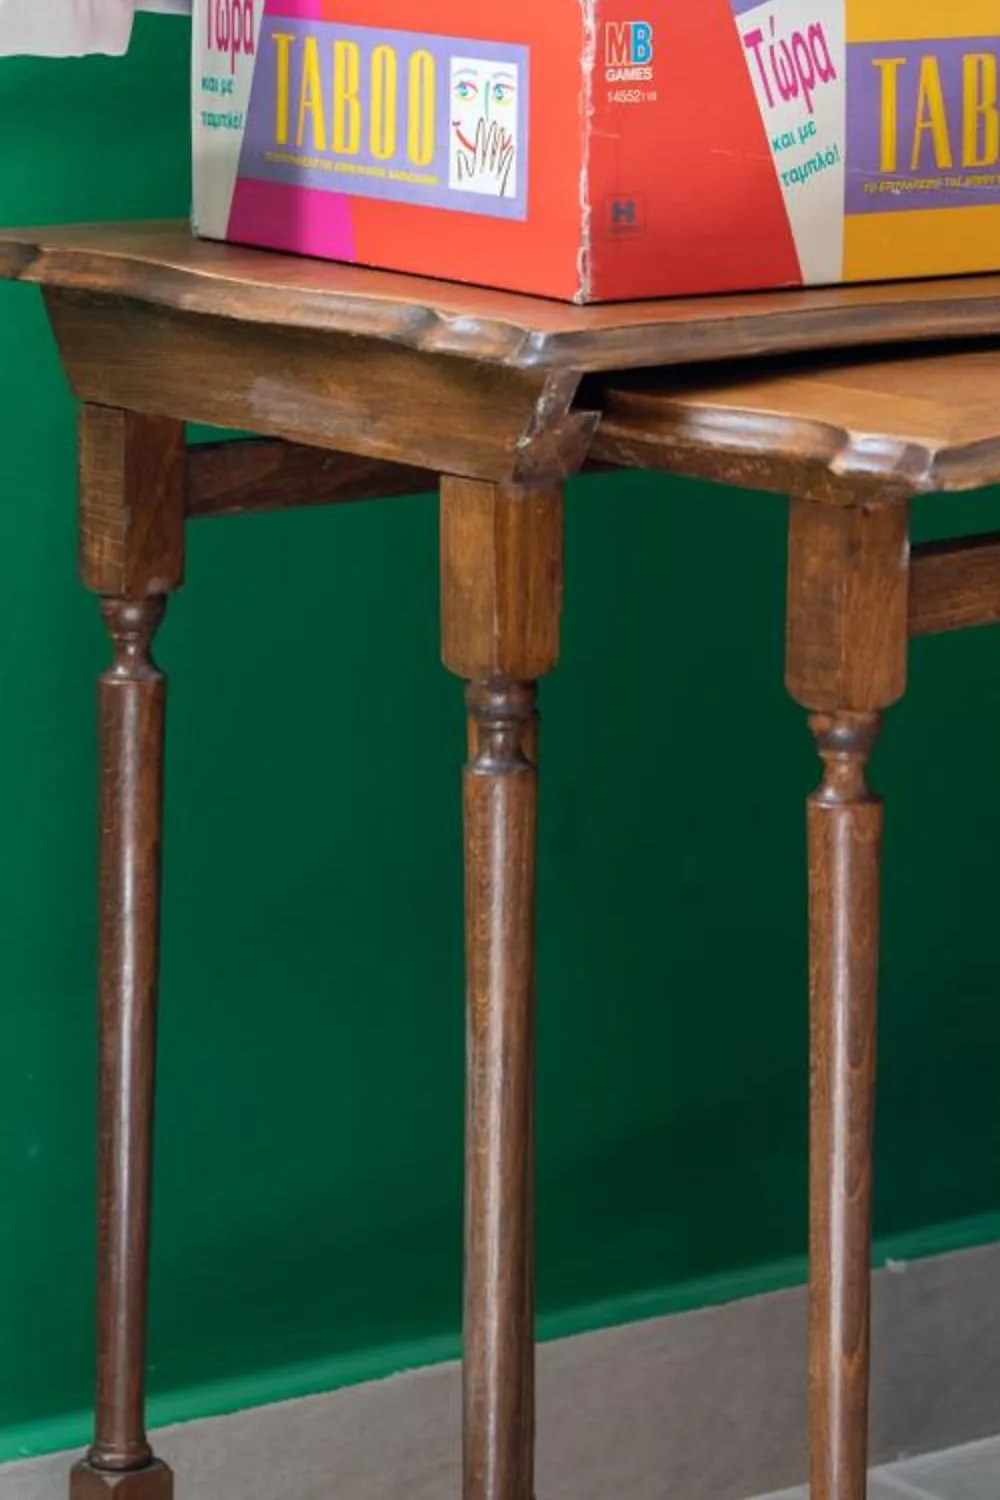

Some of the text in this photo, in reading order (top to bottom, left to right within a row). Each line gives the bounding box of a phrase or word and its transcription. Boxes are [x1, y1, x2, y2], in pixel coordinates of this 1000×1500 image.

[605, 21, 653, 67] MB
[743, 15, 837, 114] Τώρα
[605, 67, 653, 82] GAMES
[271, 32, 437, 167] TABOO
[772, 120, 817, 153] και με
[780, 143, 841, 188] ταμπλό!
